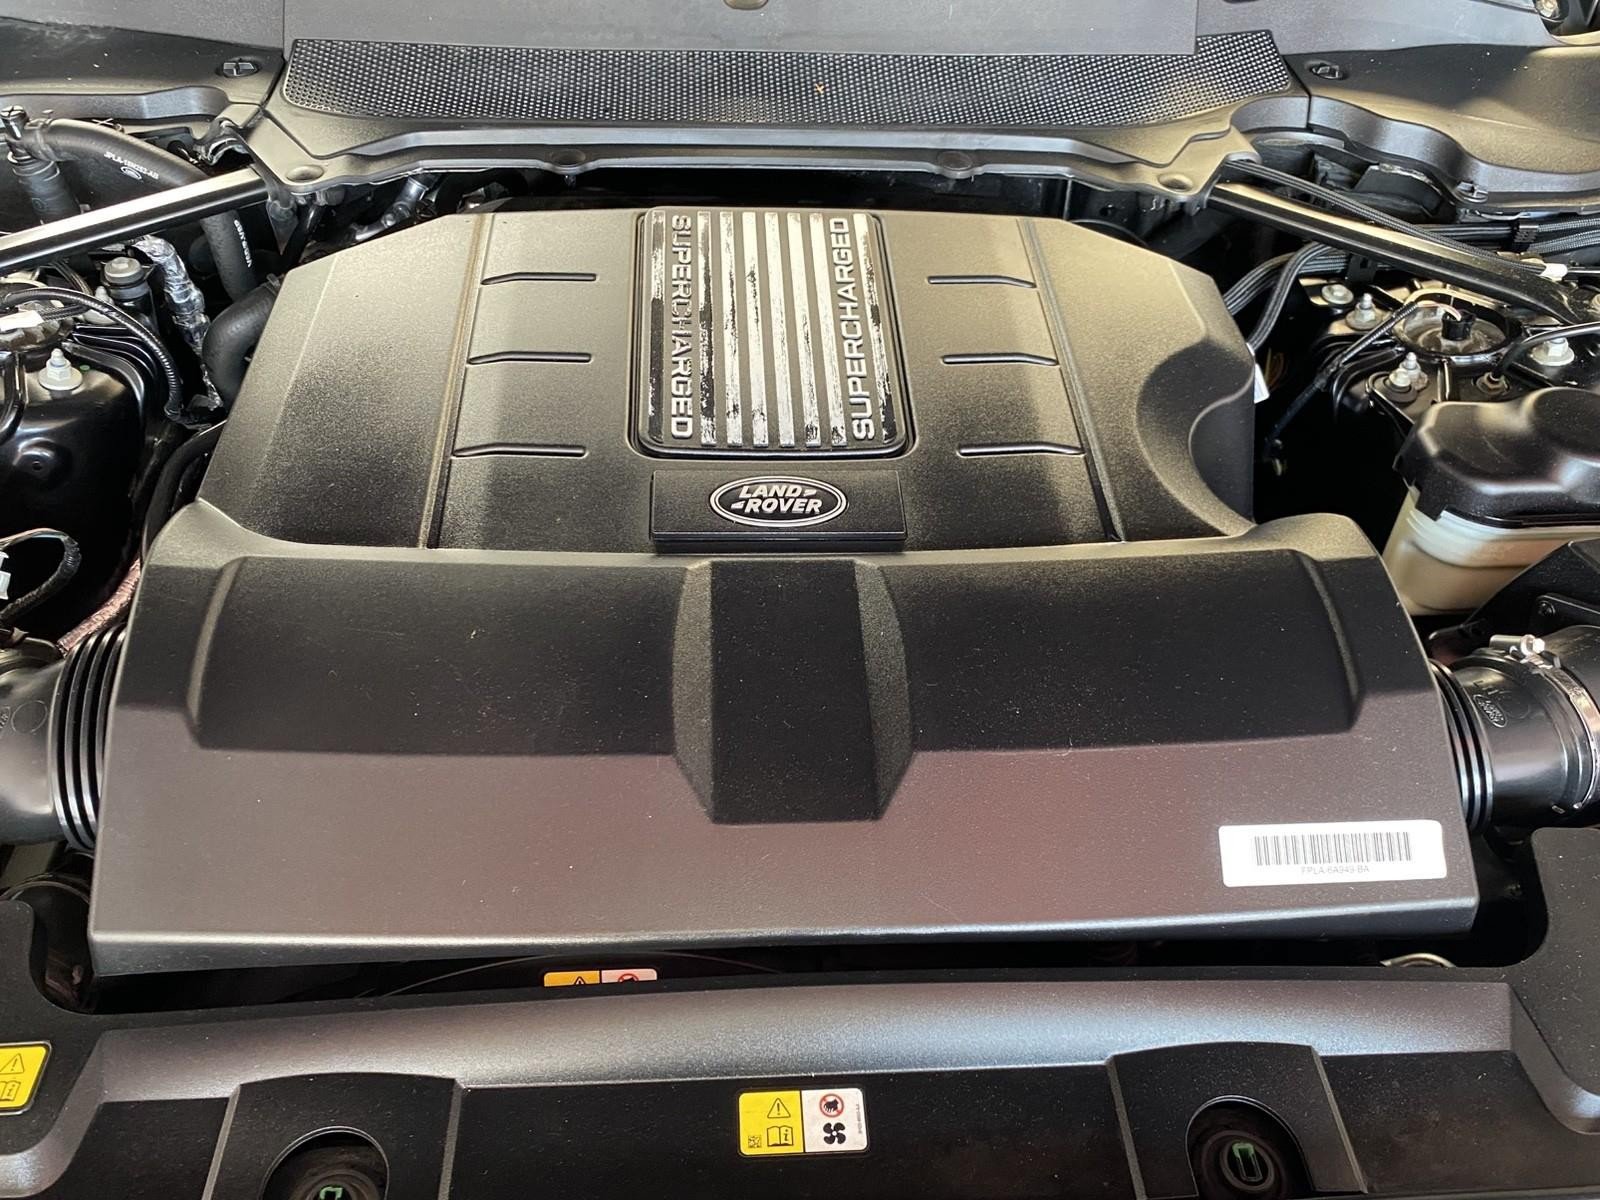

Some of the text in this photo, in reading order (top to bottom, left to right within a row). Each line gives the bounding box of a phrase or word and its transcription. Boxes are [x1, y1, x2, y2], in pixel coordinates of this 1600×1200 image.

[671, 215, 693, 440] SUPERCHARGED
[829, 217, 876, 441] SUPERCHARGED
[738, 484, 803, 499] LAND
[744, 498, 823, 514] ROVER
